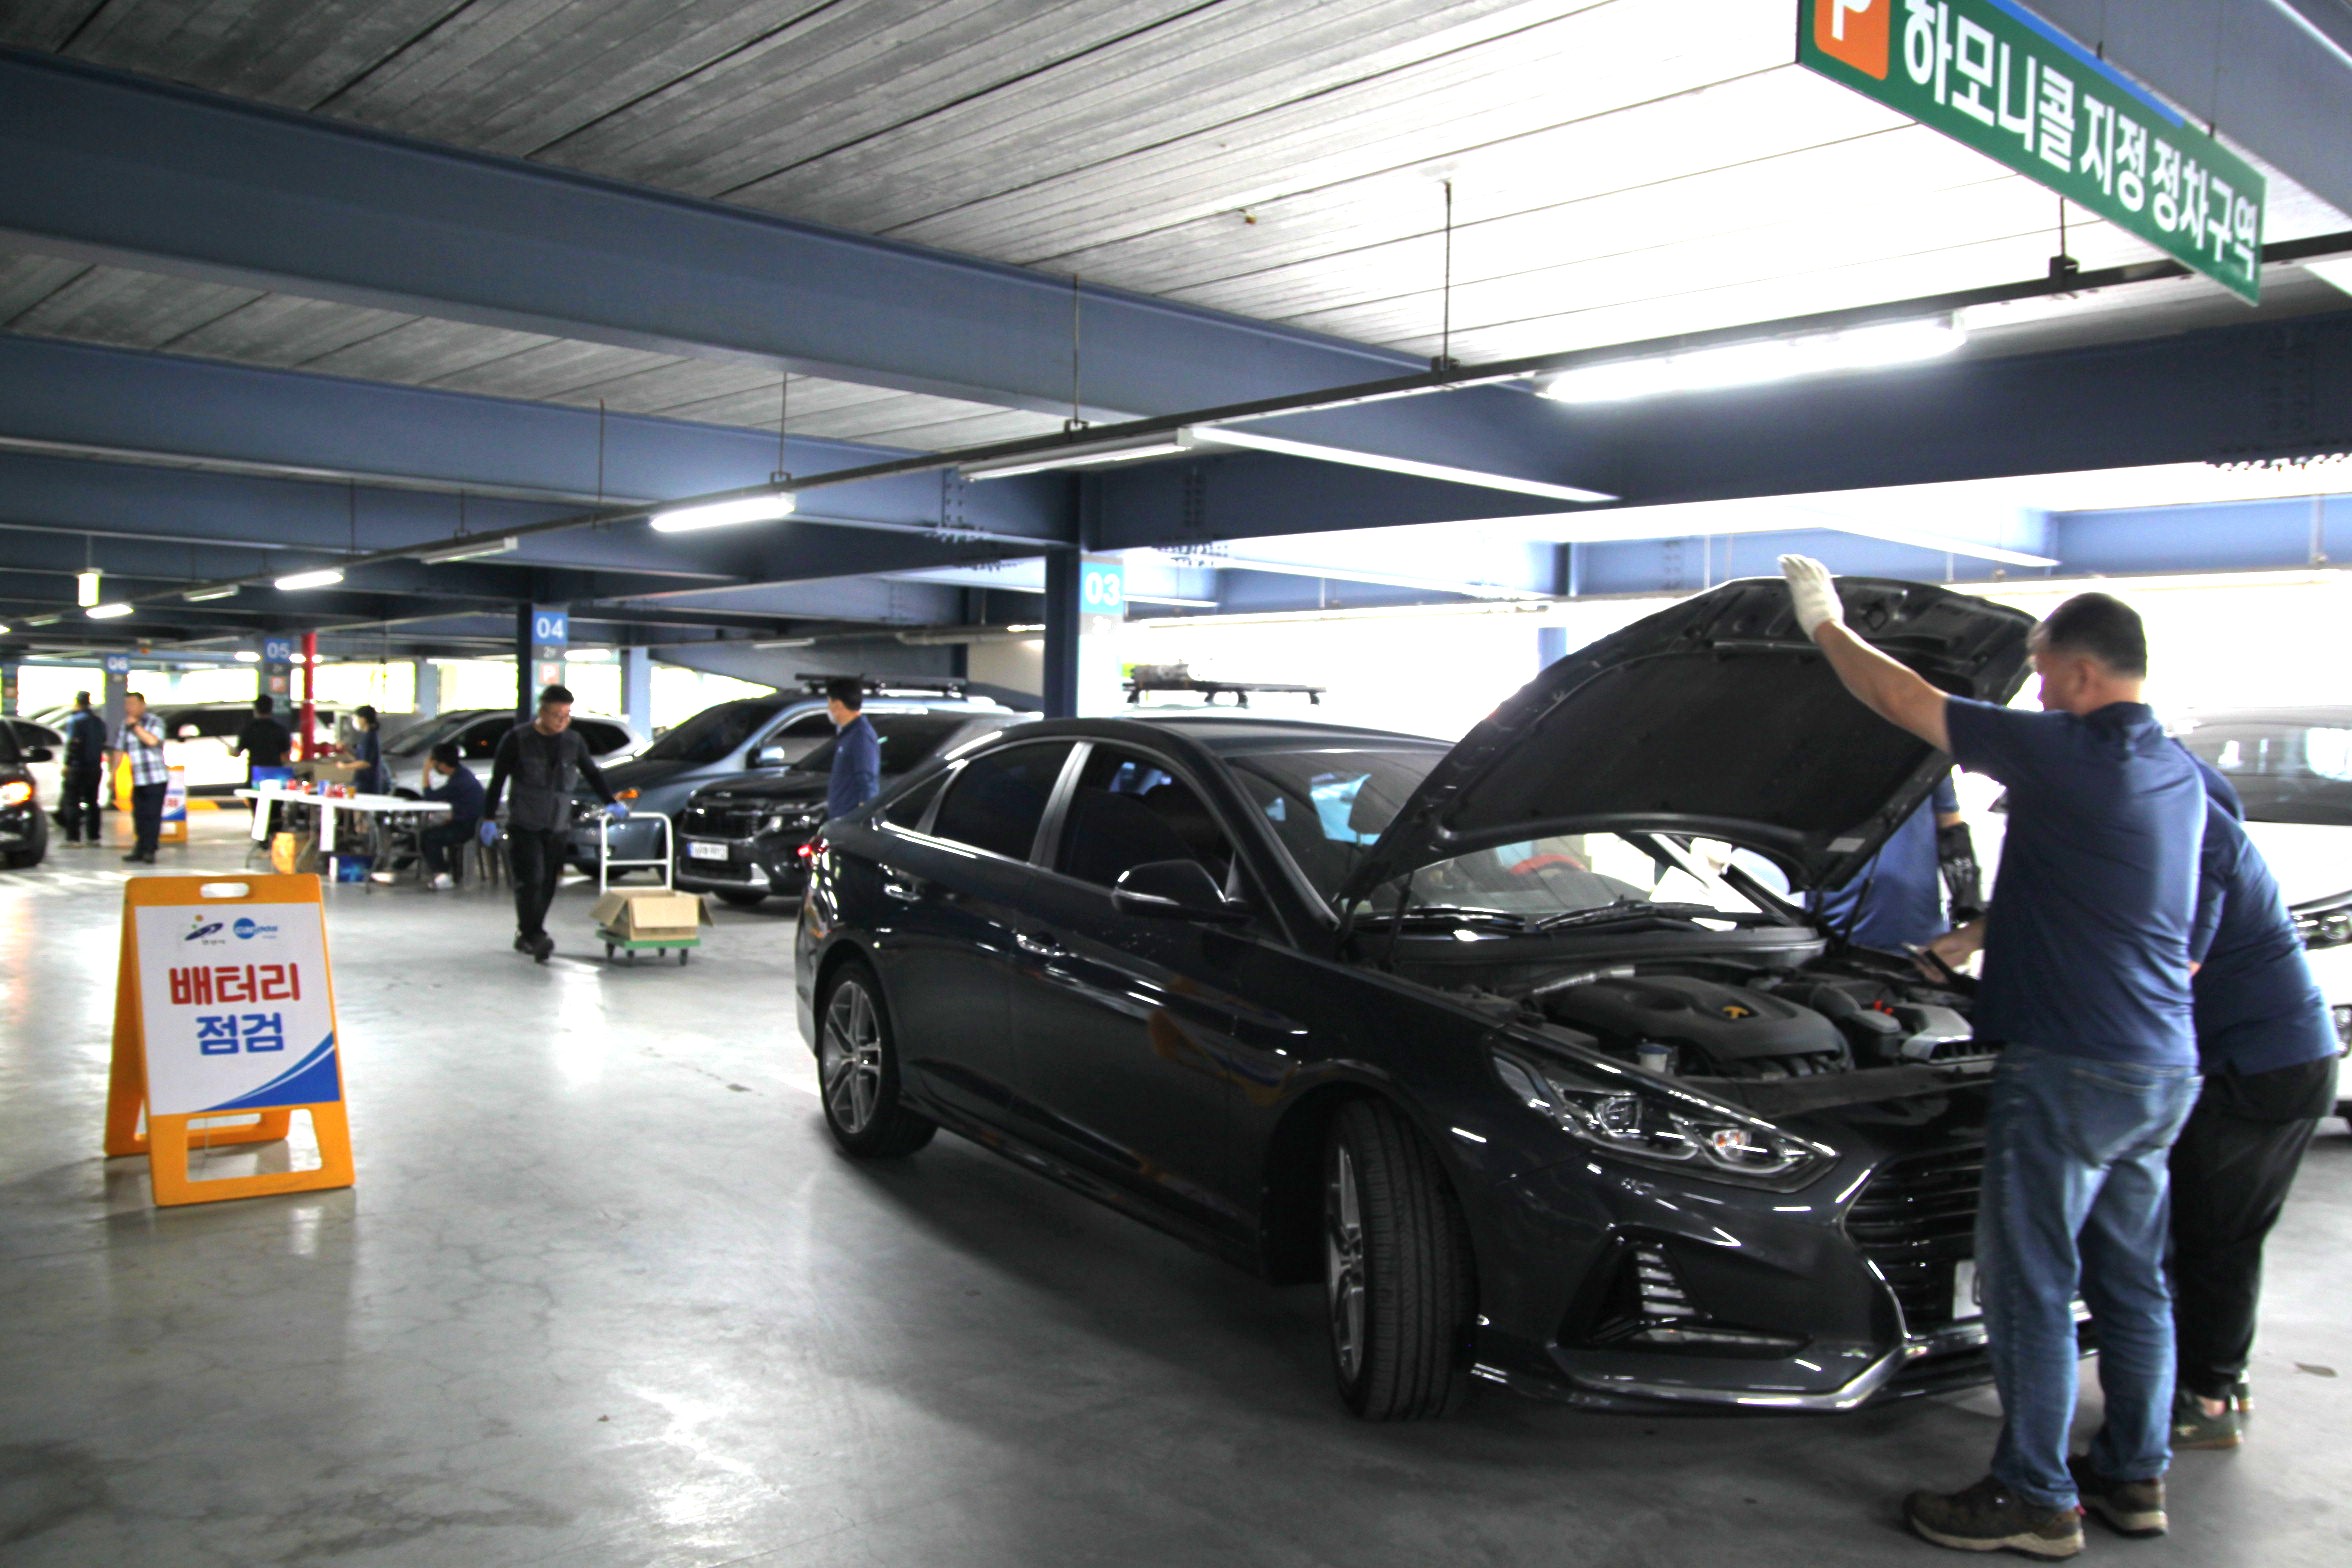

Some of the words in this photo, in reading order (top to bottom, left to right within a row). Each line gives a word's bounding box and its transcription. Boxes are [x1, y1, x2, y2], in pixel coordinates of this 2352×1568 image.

[1904, 0, 2075, 173] 하모니콜
[2080, 94, 2148, 212] 지정
[2151, 138, 2258, 282] 정차구역
[1085, 571, 1121, 606] 03
[536, 616, 564, 639] 04
[267, 642, 290, 659] 05
[168, 962, 301, 1006] 배터리
[196, 1011, 285, 1056] 점검
